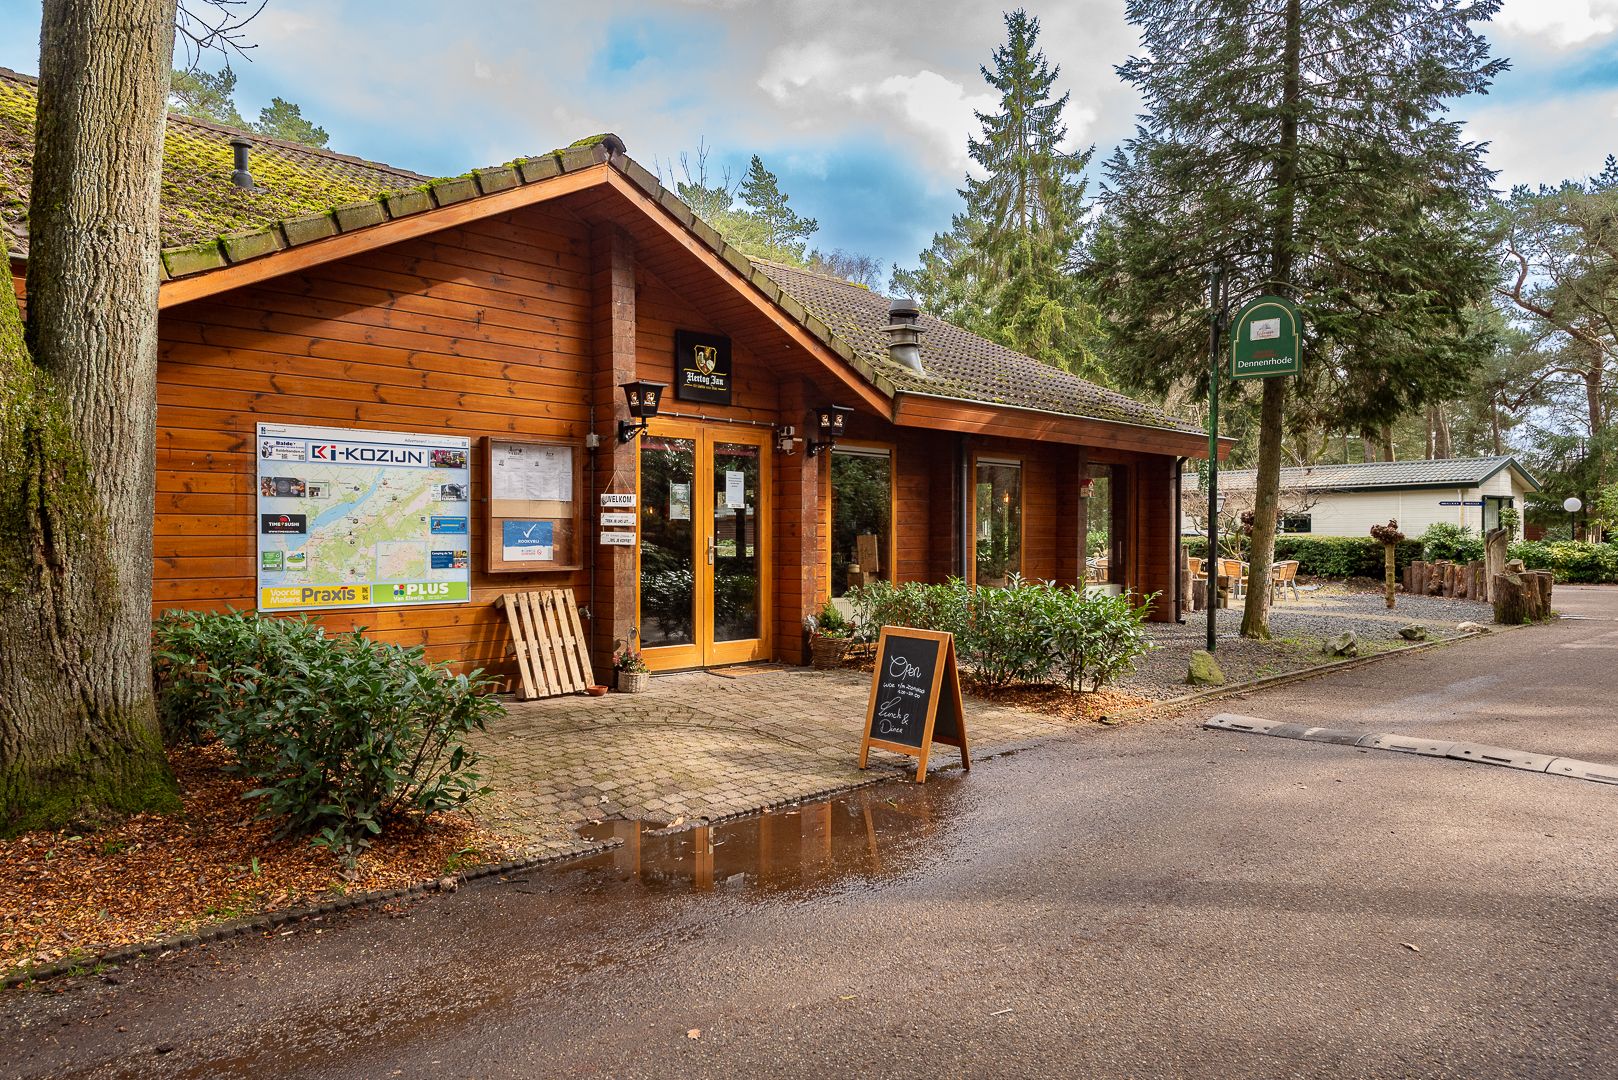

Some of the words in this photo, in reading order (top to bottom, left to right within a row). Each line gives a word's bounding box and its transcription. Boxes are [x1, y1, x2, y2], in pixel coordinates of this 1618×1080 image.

[1238, 356, 1292, 368] Dennenrhode
[687, 372, 710, 385] Hertog
[710, 374, 724, 386] Jan
[606, 495, 632, 504] WELKOM
[270, 588, 288, 597] Voor
[289, 588, 300, 596] de
[301, 586, 356, 603] Praxis
[406, 582, 449, 596] PLUS
[270, 596, 300, 604] Makers
[889, 655, 922, 681] Open
[878, 696, 902, 719] Lunch
[901, 713, 909, 726] &
